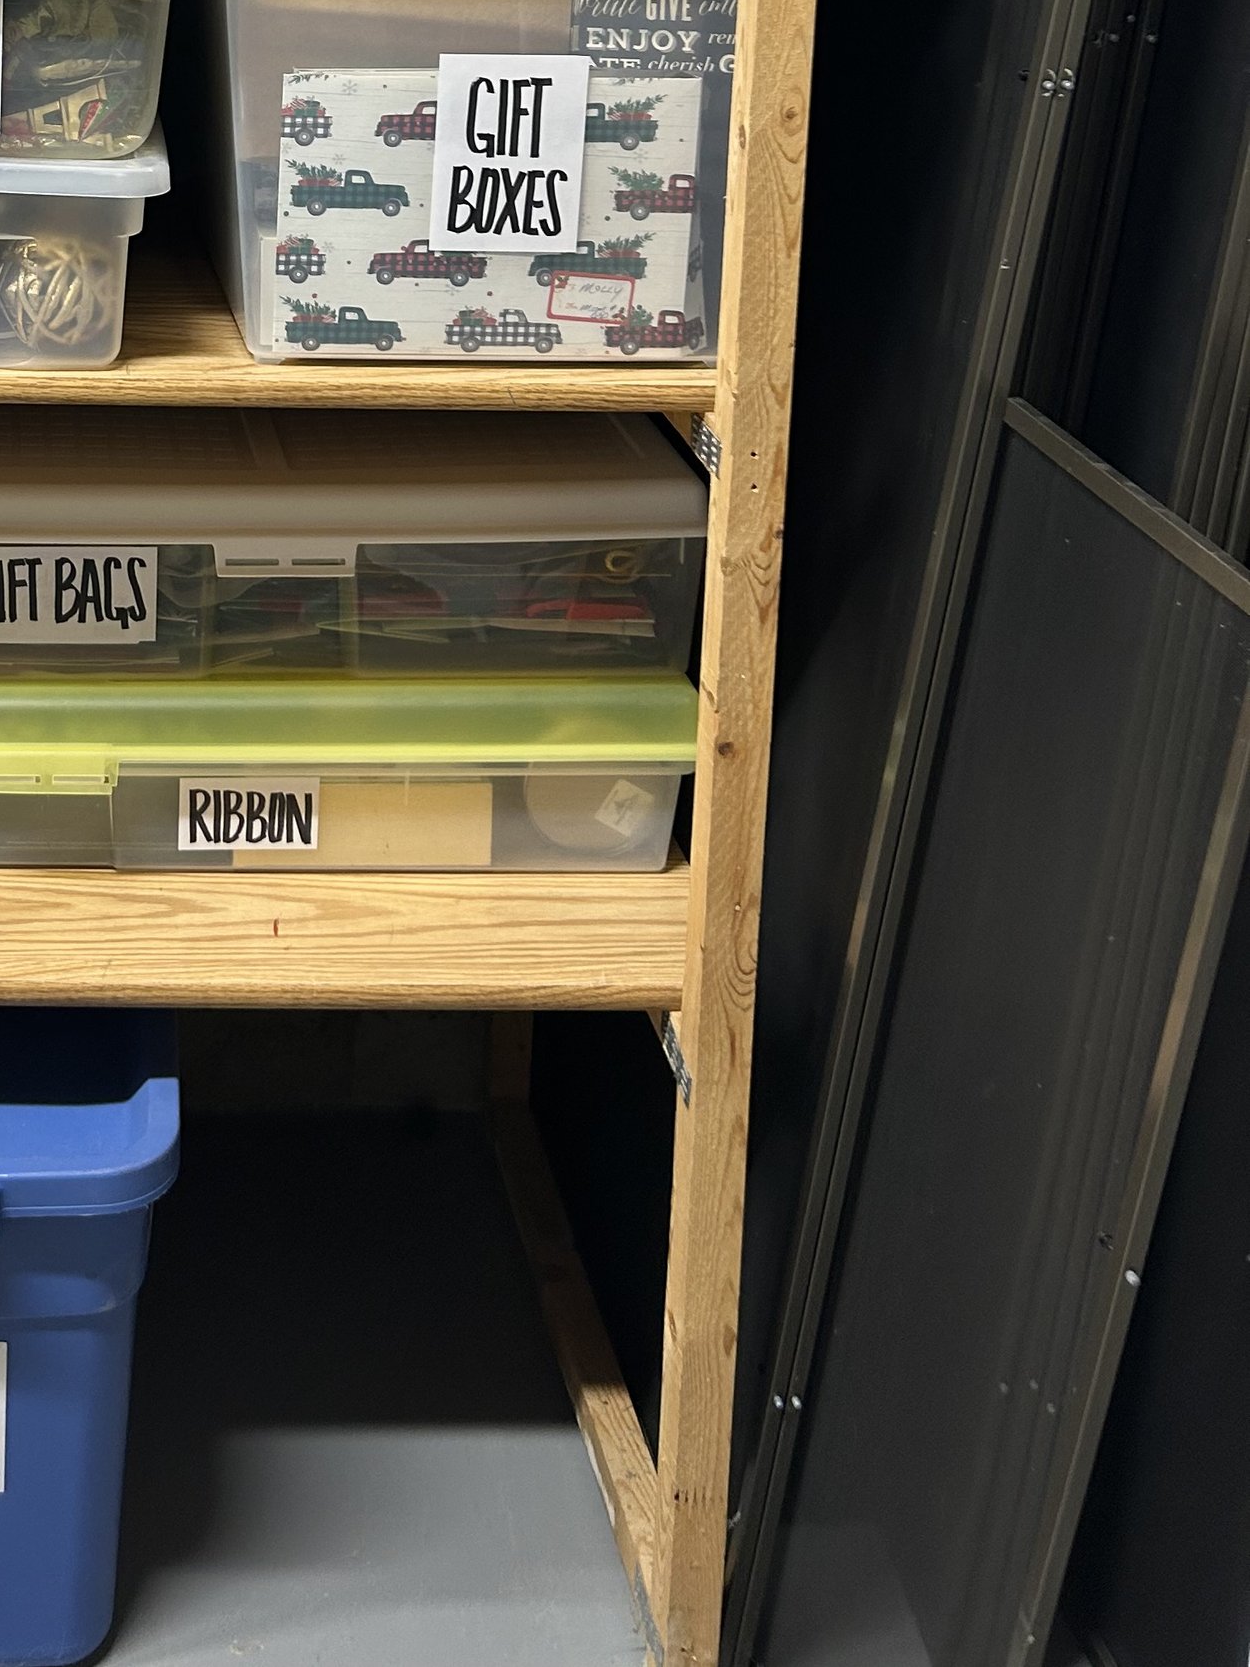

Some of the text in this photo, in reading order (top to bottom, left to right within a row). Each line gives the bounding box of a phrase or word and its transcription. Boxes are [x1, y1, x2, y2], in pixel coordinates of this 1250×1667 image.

[586, 26, 701, 53] ENJOY
[647, 55, 715, 73] cherish
[467, 77, 552, 158] GIFT
[447, 166, 567, 236] BOXES
[55, 557, 146, 629] BAGS
[190, 789, 312, 844] RIBBON
